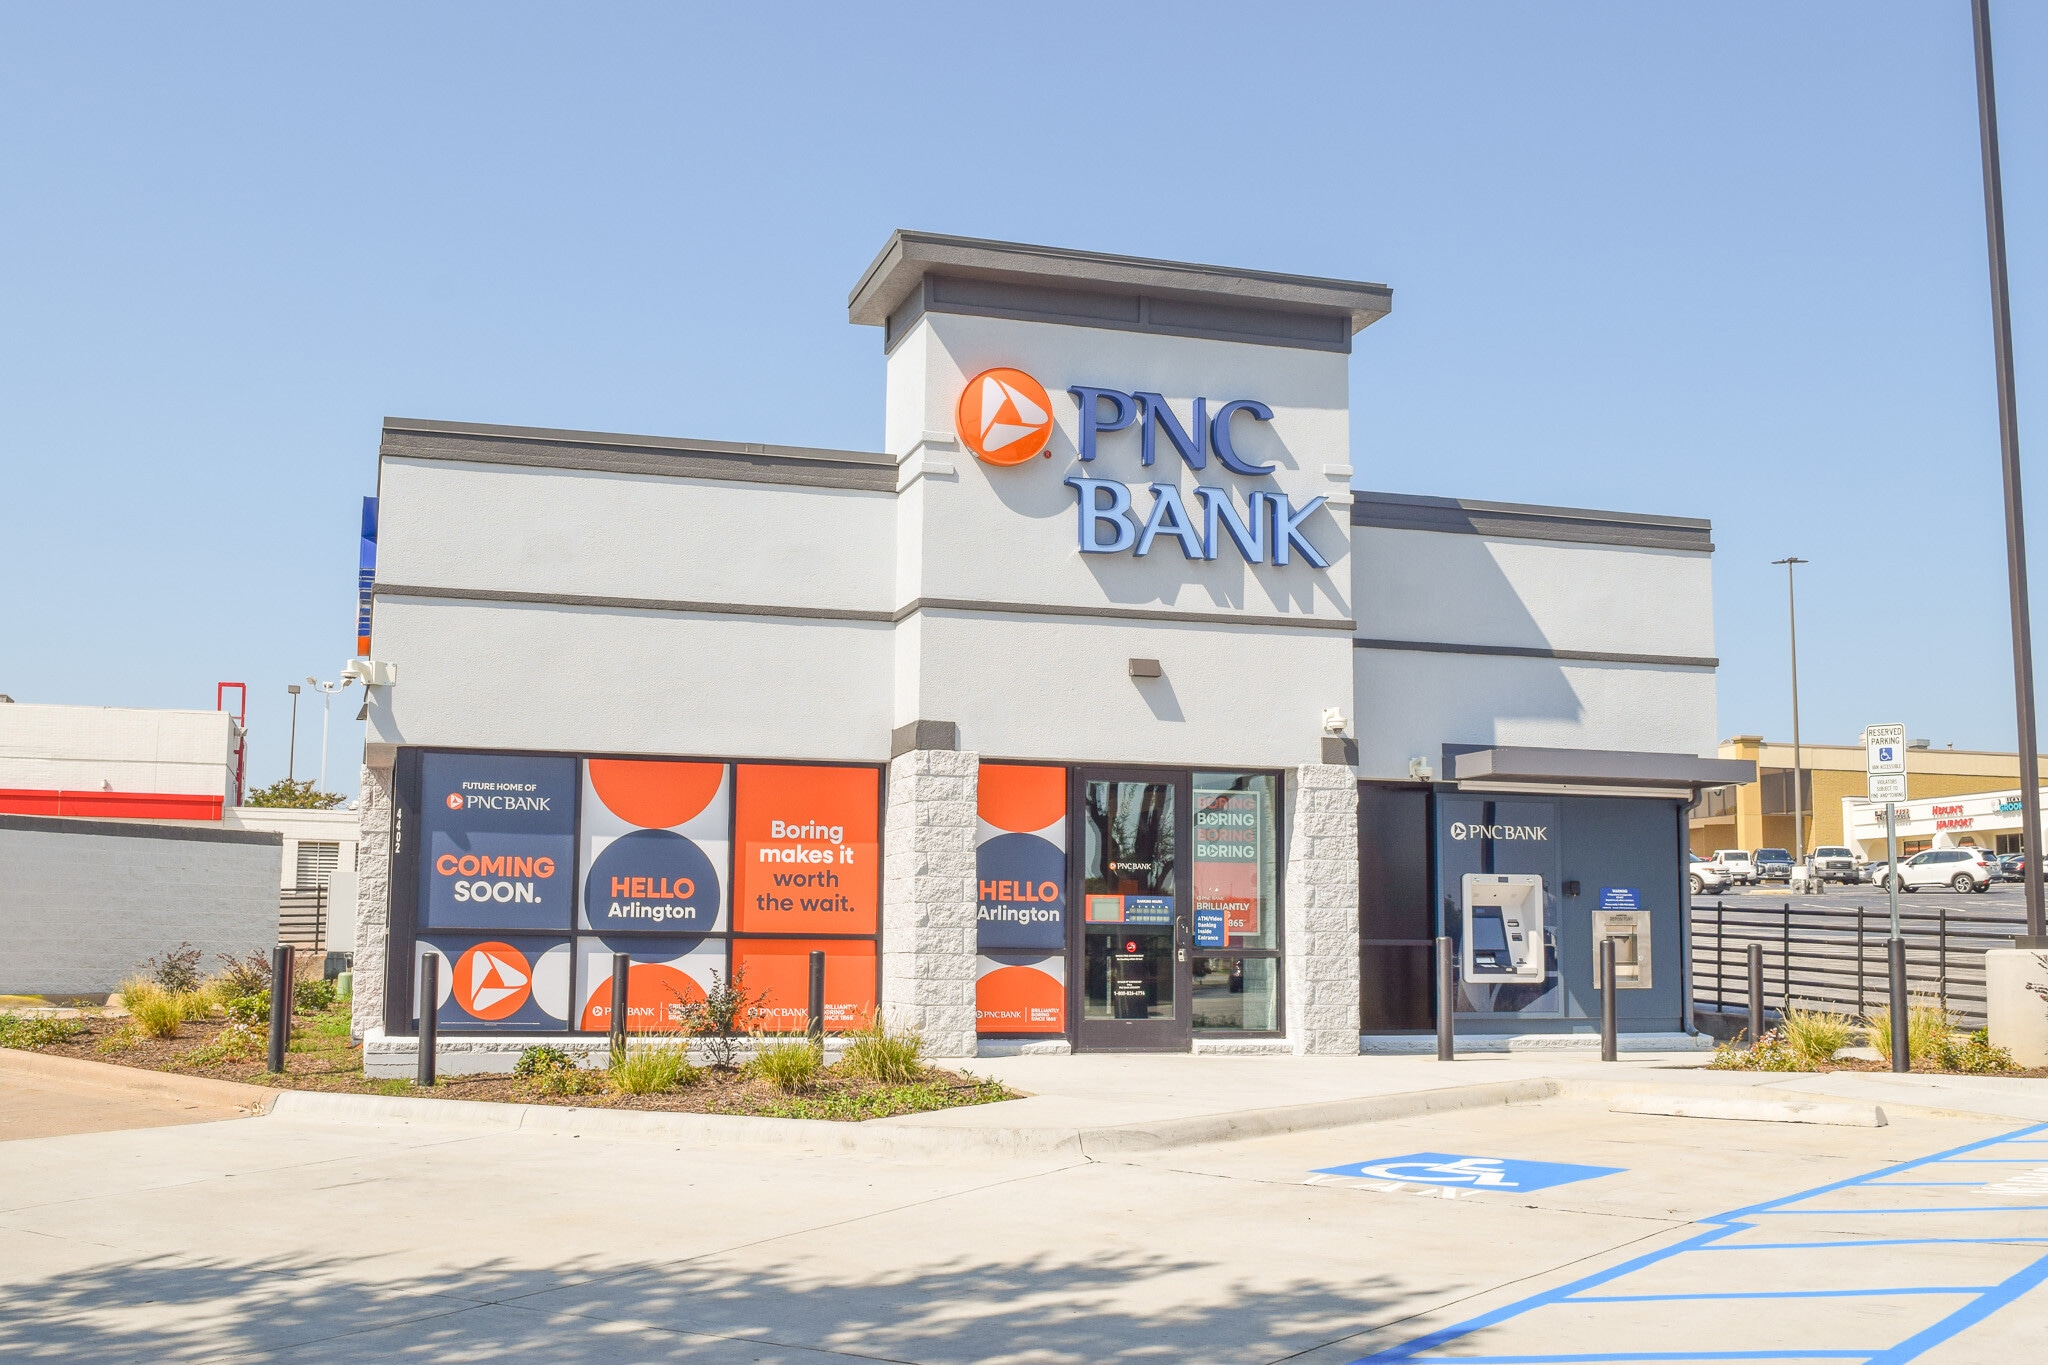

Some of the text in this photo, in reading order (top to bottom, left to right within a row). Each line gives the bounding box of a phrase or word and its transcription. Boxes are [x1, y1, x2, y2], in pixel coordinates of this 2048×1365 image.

[1066, 385, 1276, 476] PNC
[1063, 476, 1331, 569] BANK
[1868, 727, 1902, 736] RESERVED
[1871, 736, 1900, 745] PARKING
[462, 782, 495, 790] FUTURE
[497, 783, 523, 791] HOME
[466, 795, 551, 811] PNC BANK
[1197, 796, 1255, 810] BORING
[771, 820, 844, 844] Boring
[1197, 829, 1255, 842] BORING
[1468, 824, 1547, 840] PNC BANK
[760, 844, 854, 864] makes it
[436, 854, 555, 879] COMING
[773, 870, 839, 887] worth
[454, 880, 542, 903] SOON.
[611, 876, 695, 899] HELLO
[979, 880, 1059, 903] HELLO
[757, 893, 855, 912] the wait.
[1196, 902, 1250, 910] BRILLIANTLY
[608, 901, 696, 922] Arlington
[977, 904, 1060, 925] Arlington
[1228, 919, 1244, 927] 865
[627, 1007, 655, 1016] BANK
[760, 1008, 808, 1017] PNC BANK
